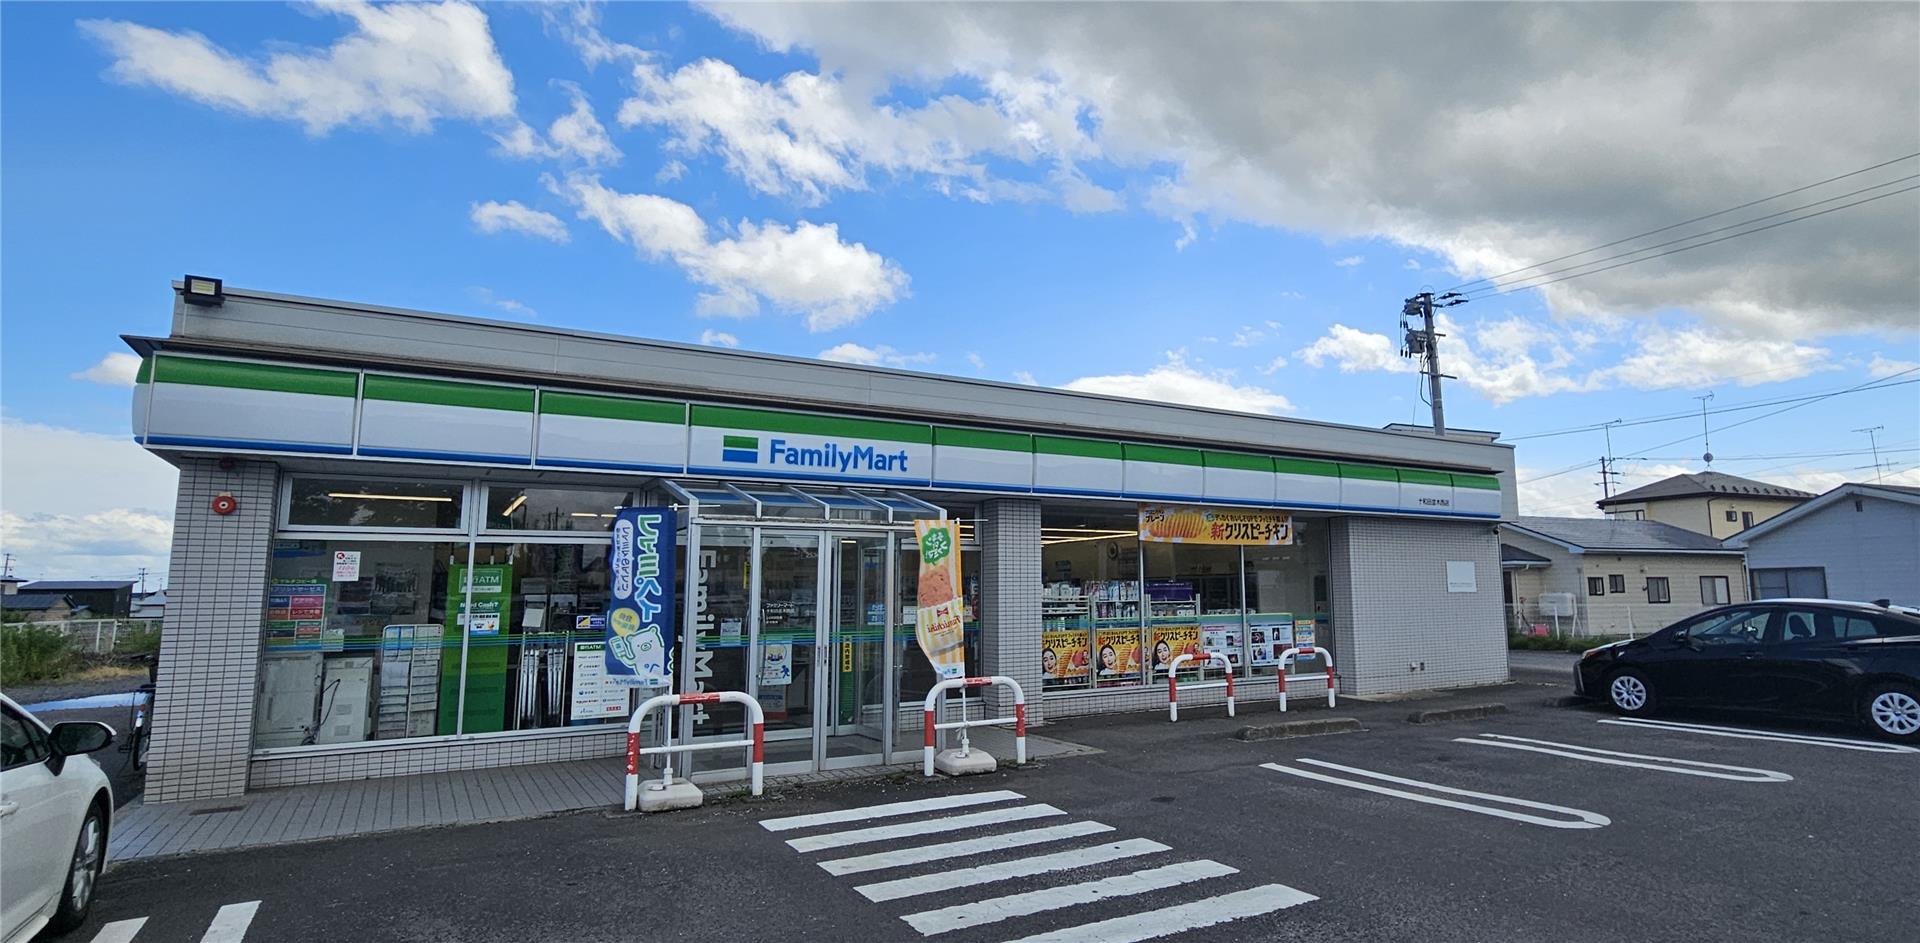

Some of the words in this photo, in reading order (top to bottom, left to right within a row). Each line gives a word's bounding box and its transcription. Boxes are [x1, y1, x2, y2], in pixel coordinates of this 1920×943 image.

[769, 439, 908, 472] FamilyMart
[1210, 522, 1289, 540] 新クリスピーチキン
